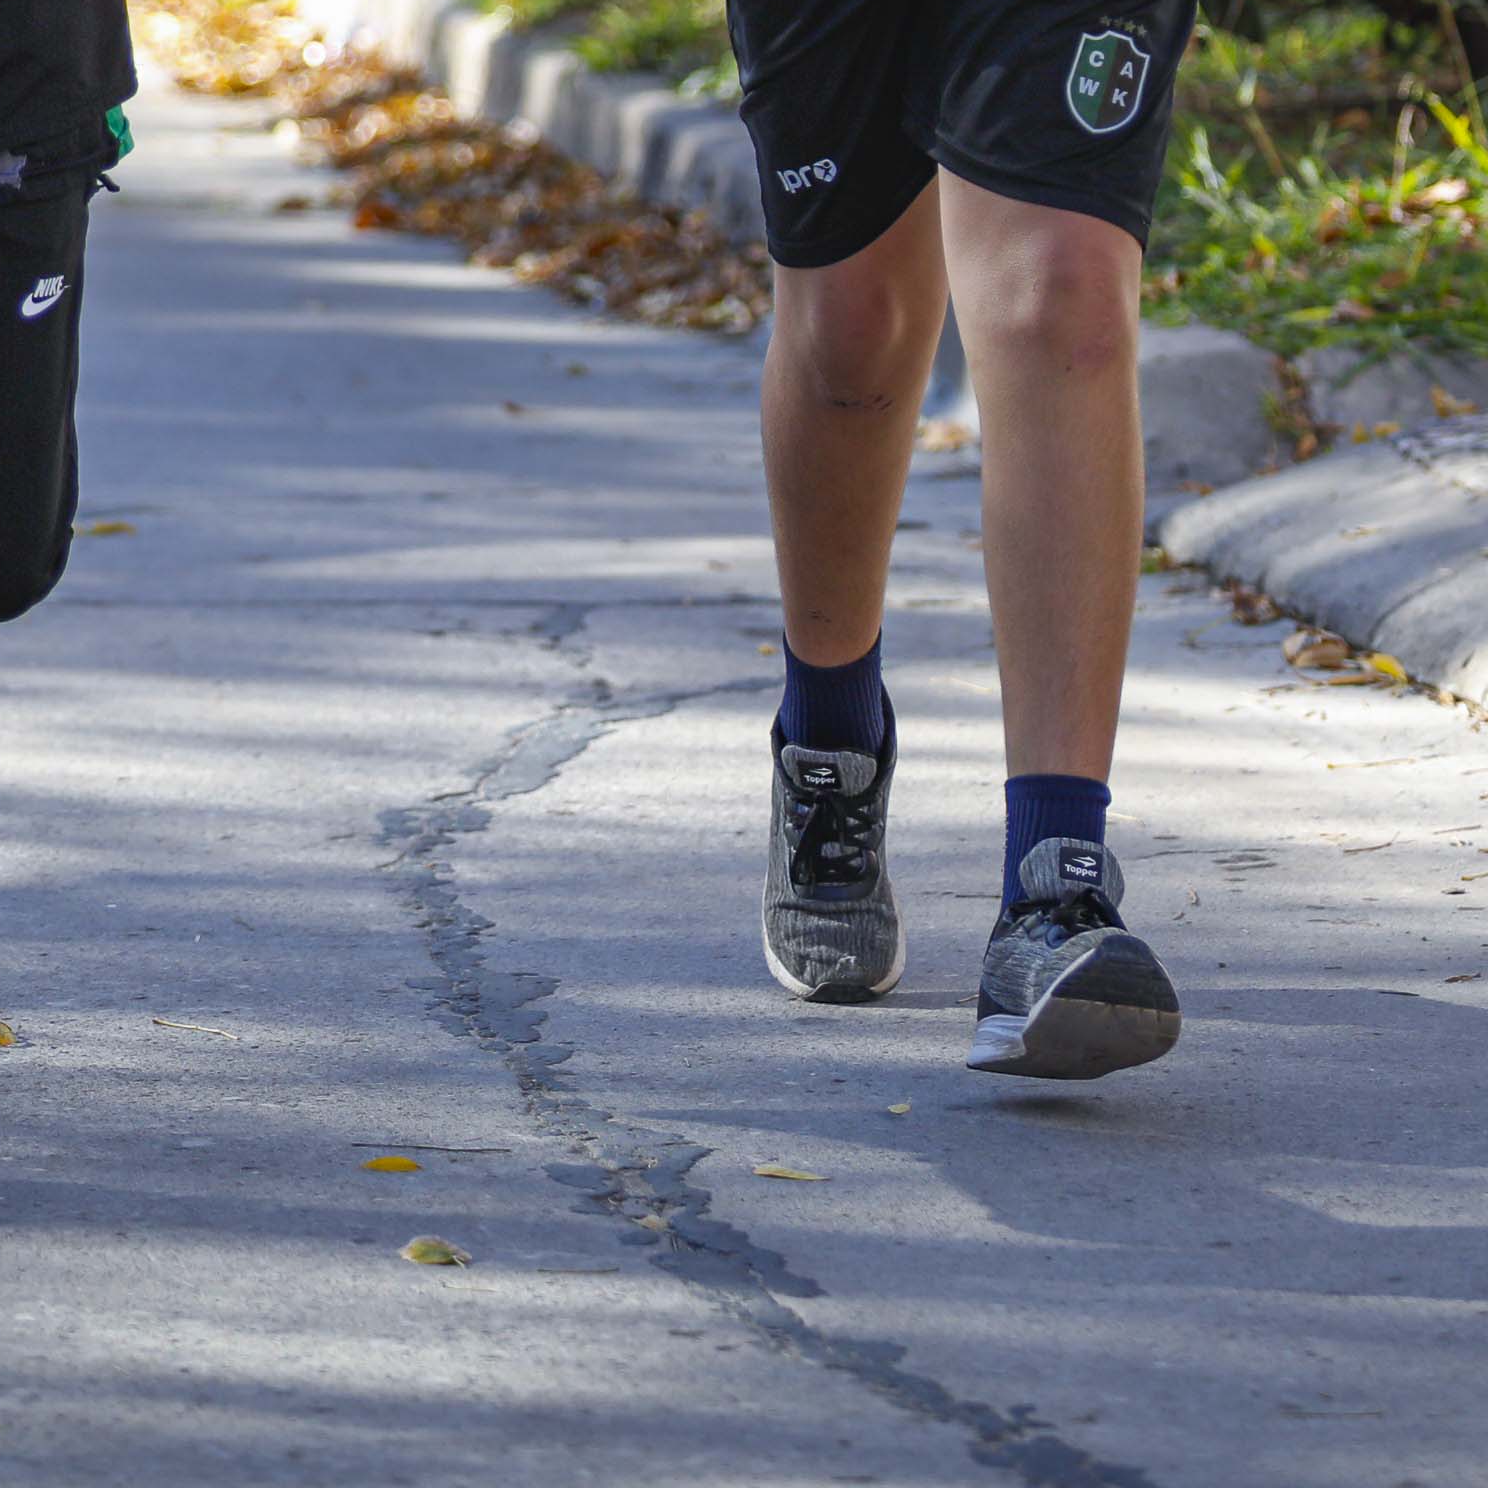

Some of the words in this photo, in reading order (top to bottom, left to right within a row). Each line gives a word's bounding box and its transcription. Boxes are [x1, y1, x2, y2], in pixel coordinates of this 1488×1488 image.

[33, 275, 65, 298] NIKE
[803, 774, 835, 785] Topper
[1064, 863, 1098, 878] Topper
